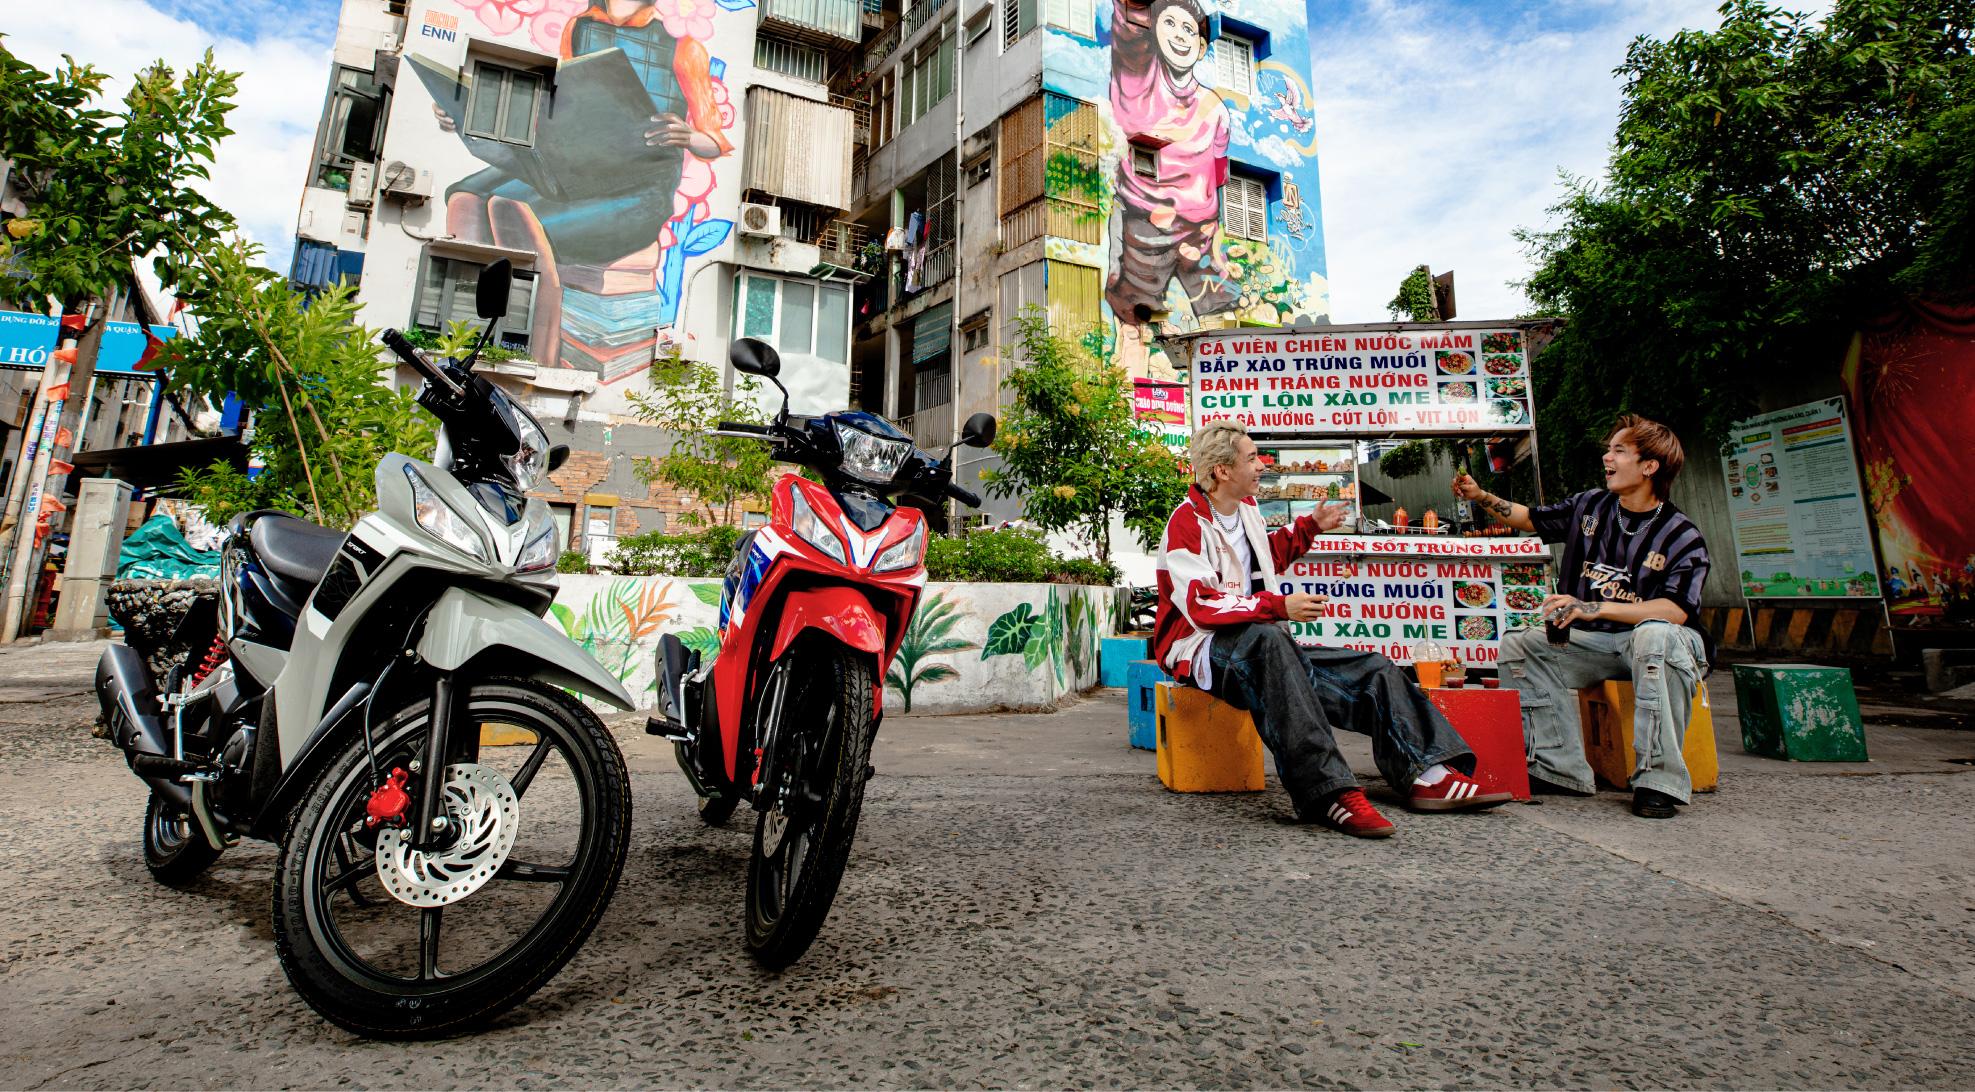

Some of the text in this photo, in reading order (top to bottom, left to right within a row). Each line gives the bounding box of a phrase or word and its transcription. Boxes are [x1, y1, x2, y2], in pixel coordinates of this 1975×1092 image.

[422, 24, 456, 43] ENNI
[1200, 331, 1473, 355] CÁ VIÊN CHIÊN NƯỚC MẮM
[8, 345, 47, 364] HÓ
[1200, 350, 1427, 373] BẮP XÀO TRỨNG MUỐI
[1200, 371, 1428, 391] BÁNH TRÁNG NƯỚNG
[1201, 390, 1431, 409] CÚT LỘN XÀO ME
[1236, 411, 1256, 427] GÀ
[1261, 410, 1315, 427] NƯỚNG
[1332, 408, 1363, 425] CÚT
[1368, 408, 1398, 427] LỘN
[1416, 410, 1441, 427] VỊT
[1447, 407, 1479, 426] LỘN
[1310, 538, 1367, 551] CHIÊN
[1371, 537, 1409, 552] SỐT
[1489, 538, 1542, 554] MUỐI
[1293, 560, 1493, 579] CHIÊN NƯỚC MẮM
[1642, 550, 1666, 572] 18
[1301, 580, 1375, 598] TRỨNG
[1384, 580, 1444, 598] MUỐI
[1361, 600, 1446, 620] NƯỚNG
[1334, 620, 1391, 638] XÀO
[1403, 624, 1448, 639] ME
[1465, 643, 1498, 665] LỘN
